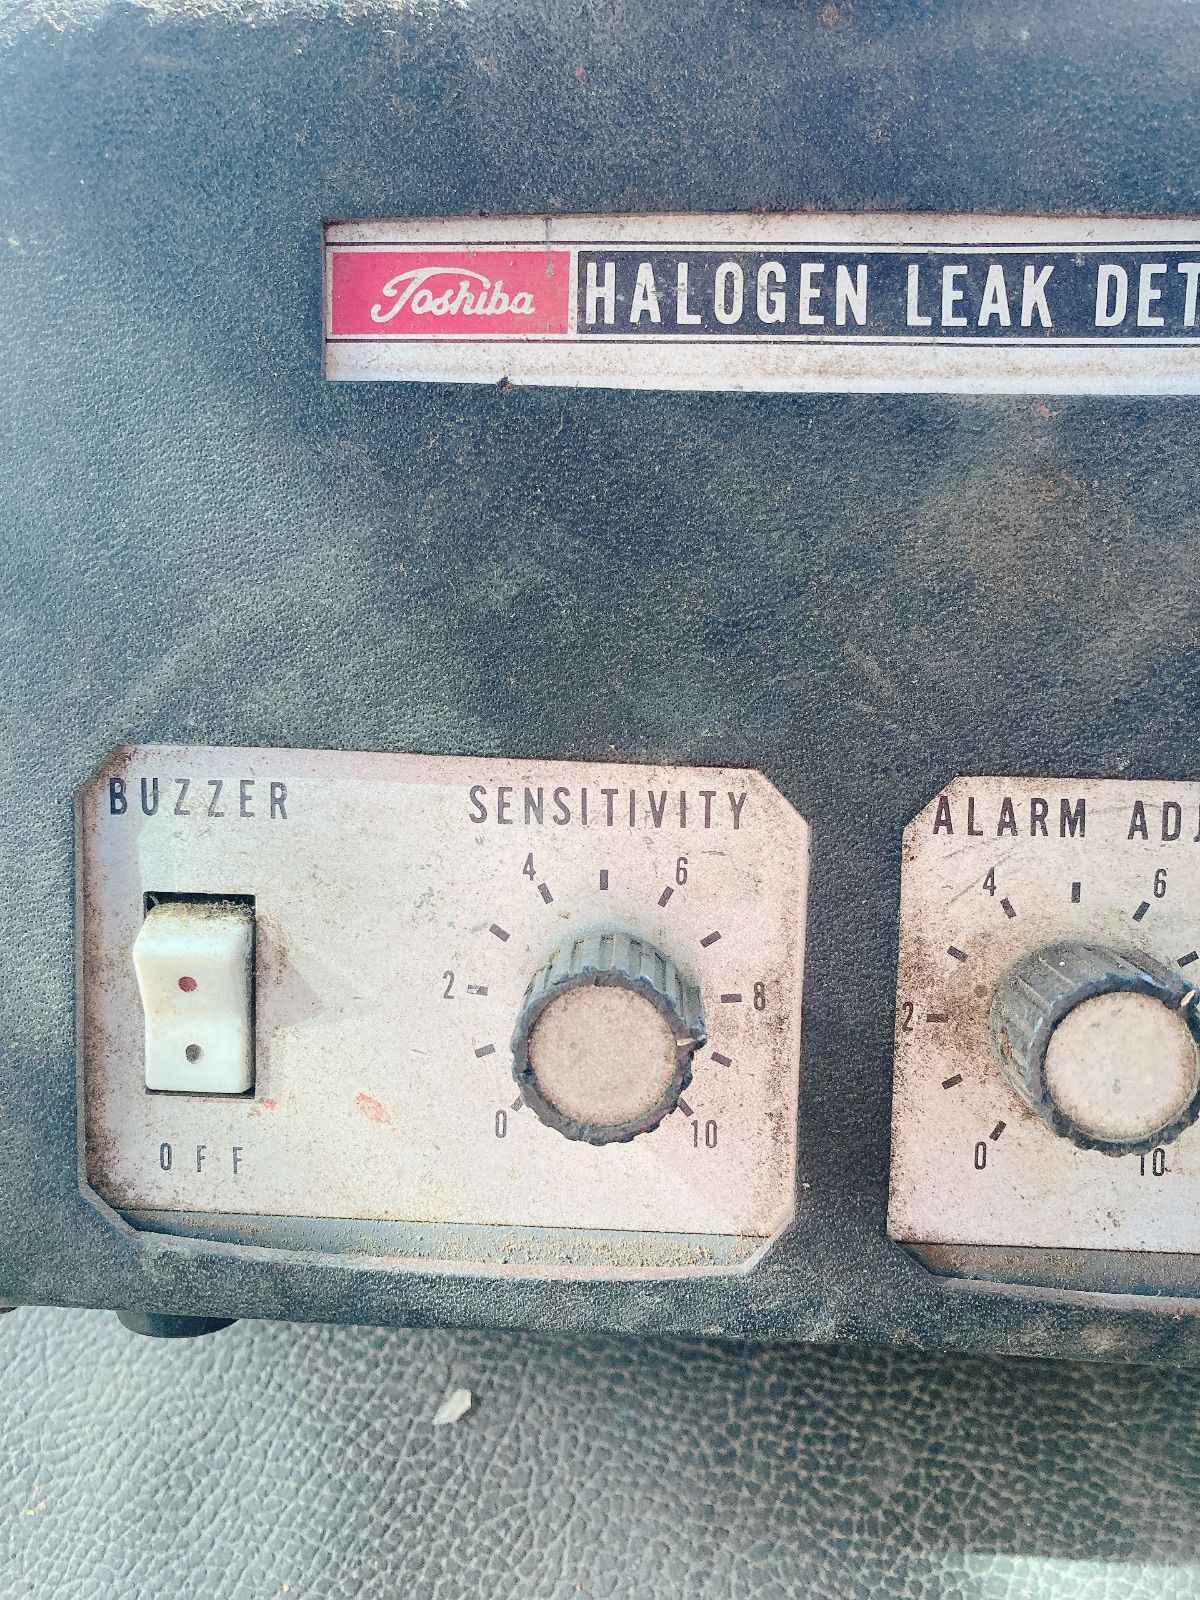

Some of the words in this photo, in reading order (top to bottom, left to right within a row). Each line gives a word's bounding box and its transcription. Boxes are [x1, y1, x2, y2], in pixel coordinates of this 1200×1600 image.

[371, 266, 536, 323] Toshiba
[585, 261, 868, 326] HALOGEN
[906, 264, 1055, 327] LEAK
[108, 777, 288, 820] BUZZER
[469, 784, 748, 830] SENSITIVITY
[932, 795, 1086, 838] ALARM
[522, 852, 536, 881] 4
[675, 856, 688, 886] 6
[982, 866, 997, 896] 4
[1153, 868, 1167, 898] 6
[442, 970, 455, 1000] 2
[753, 981, 766, 1011] 8
[901, 1001, 914, 1032] 2
[495, 1109, 507, 1138] 0
[690, 1119, 718, 1149] 10
[159, 1142, 243, 1175] OFF
[974, 1141, 987, 1170] 0
